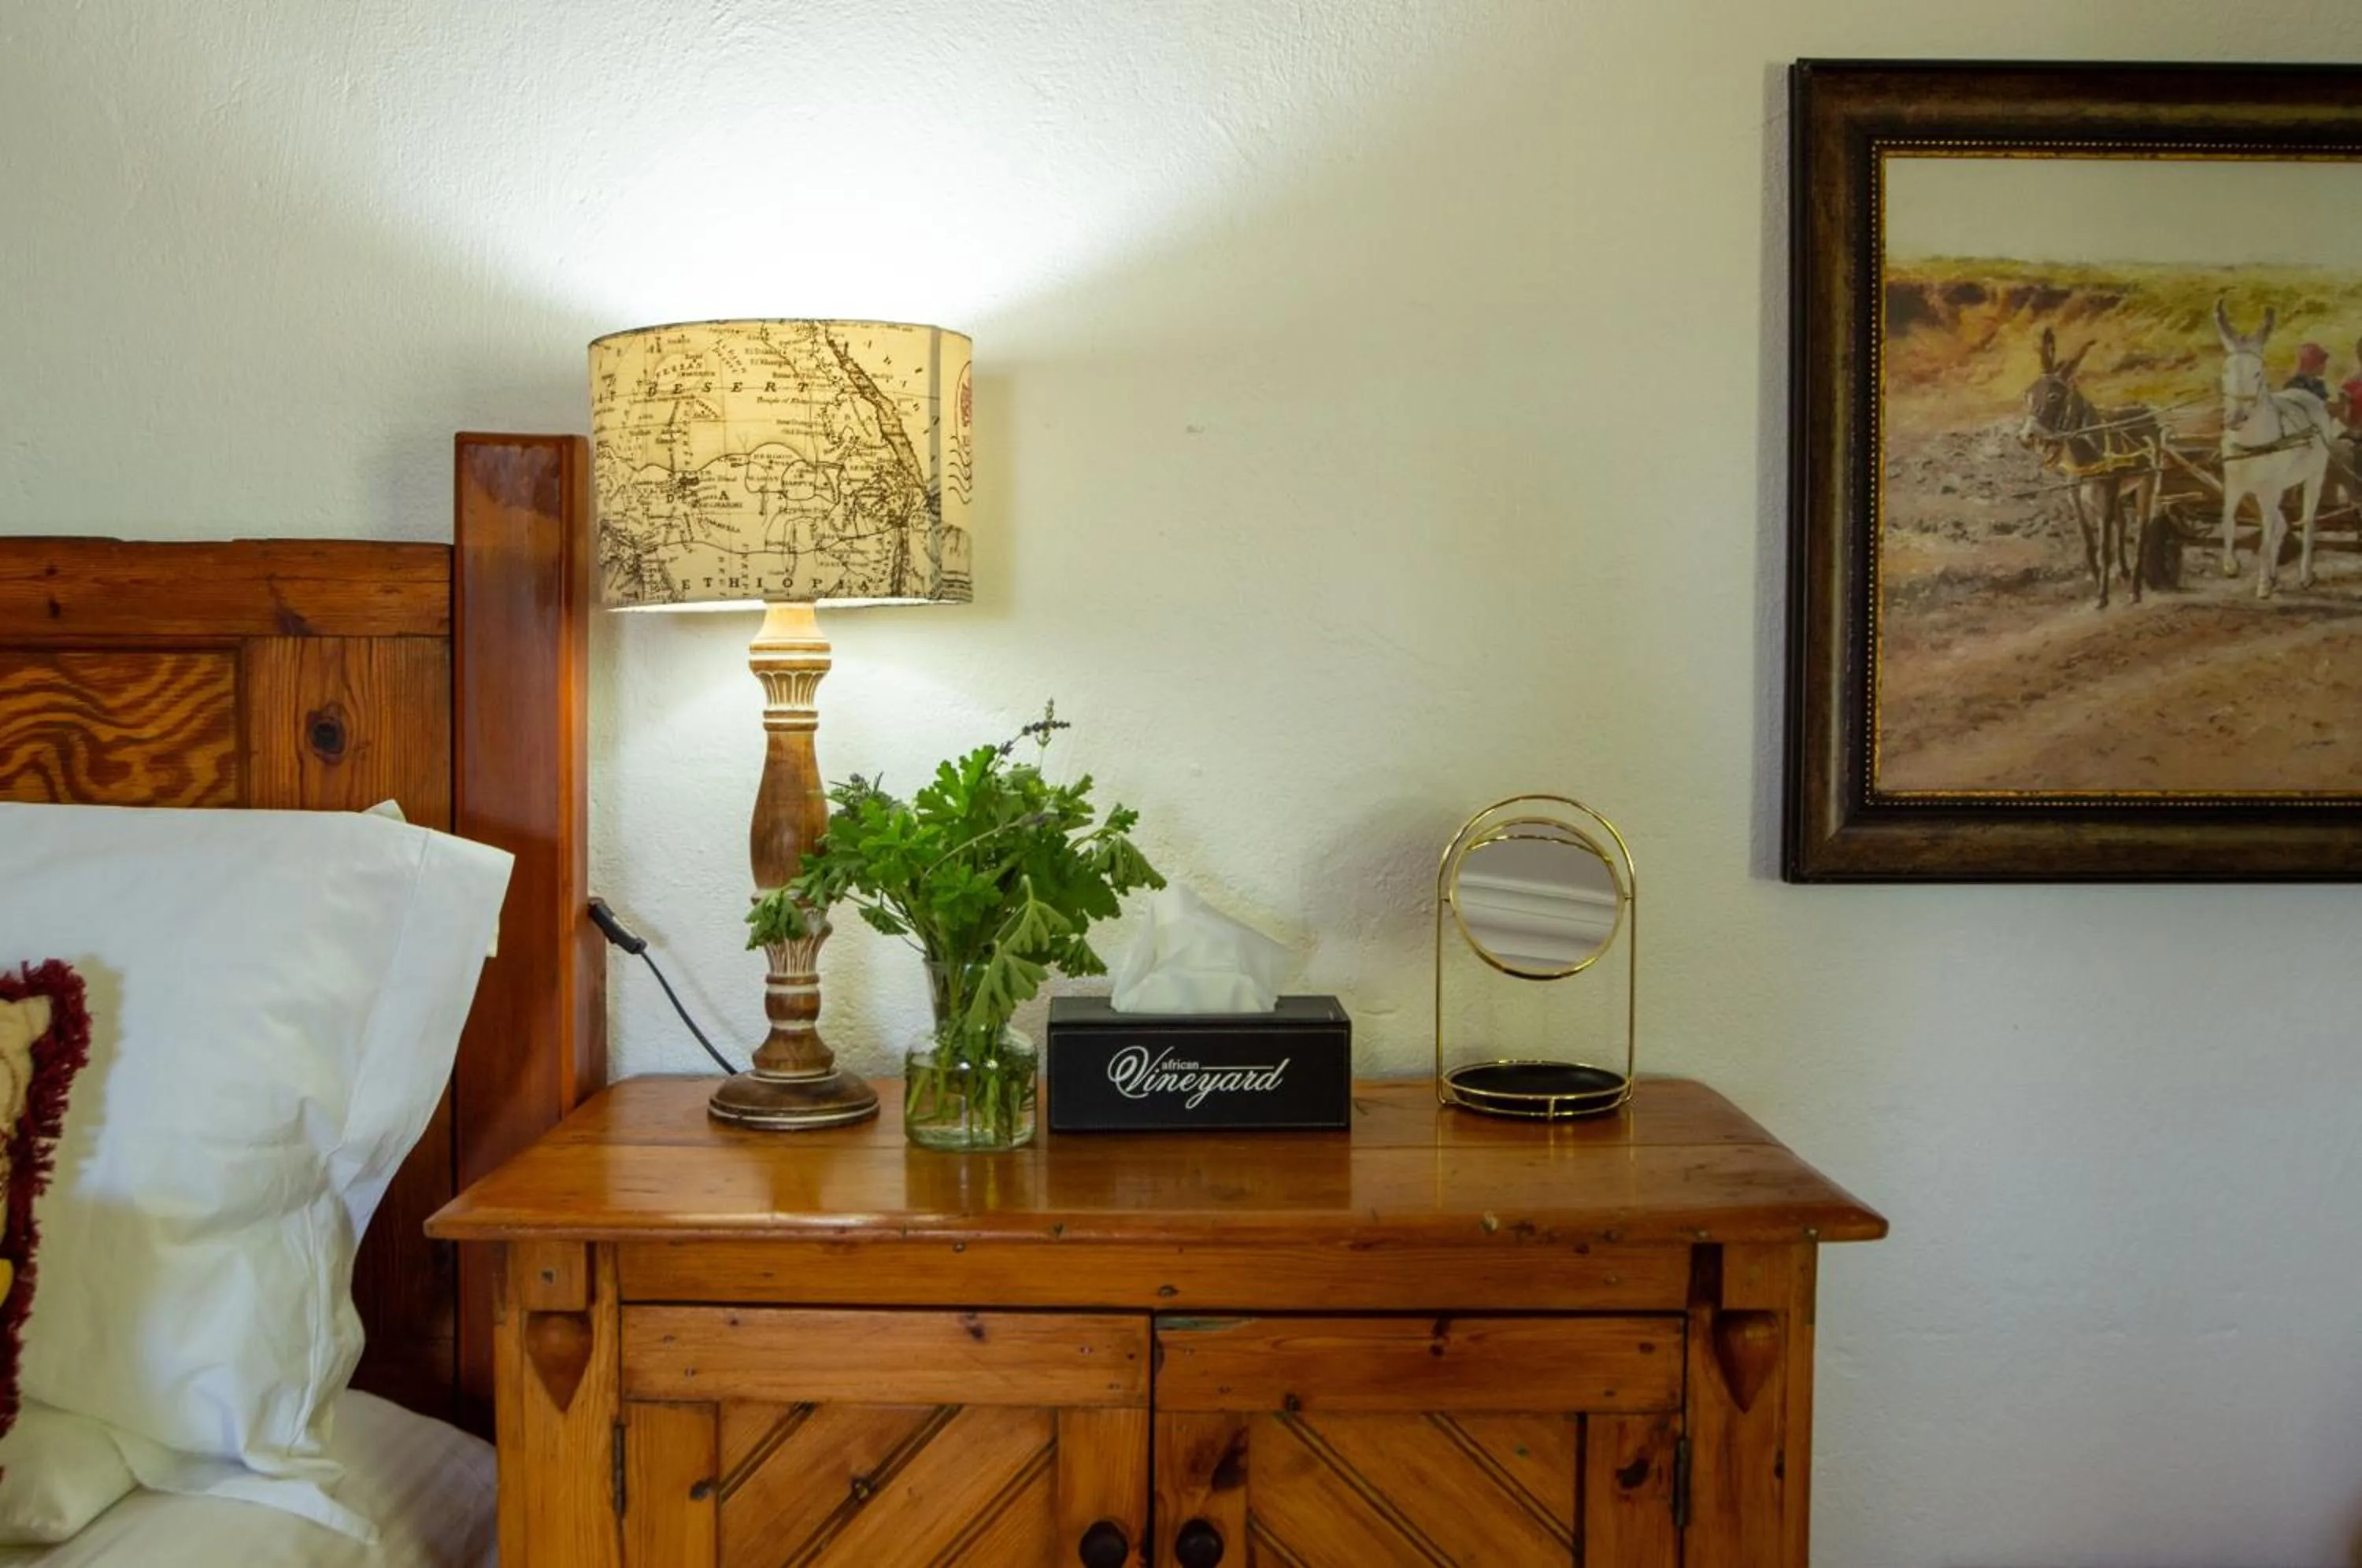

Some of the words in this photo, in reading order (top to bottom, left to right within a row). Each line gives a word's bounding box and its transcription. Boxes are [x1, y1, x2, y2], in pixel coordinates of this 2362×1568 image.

[648, 382, 809, 397] DESERT
[681, 576, 869, 592] ETHIOPIA
[1161, 1059, 1199, 1070] african
[1107, 1045, 1290, 1109] Vineyard
